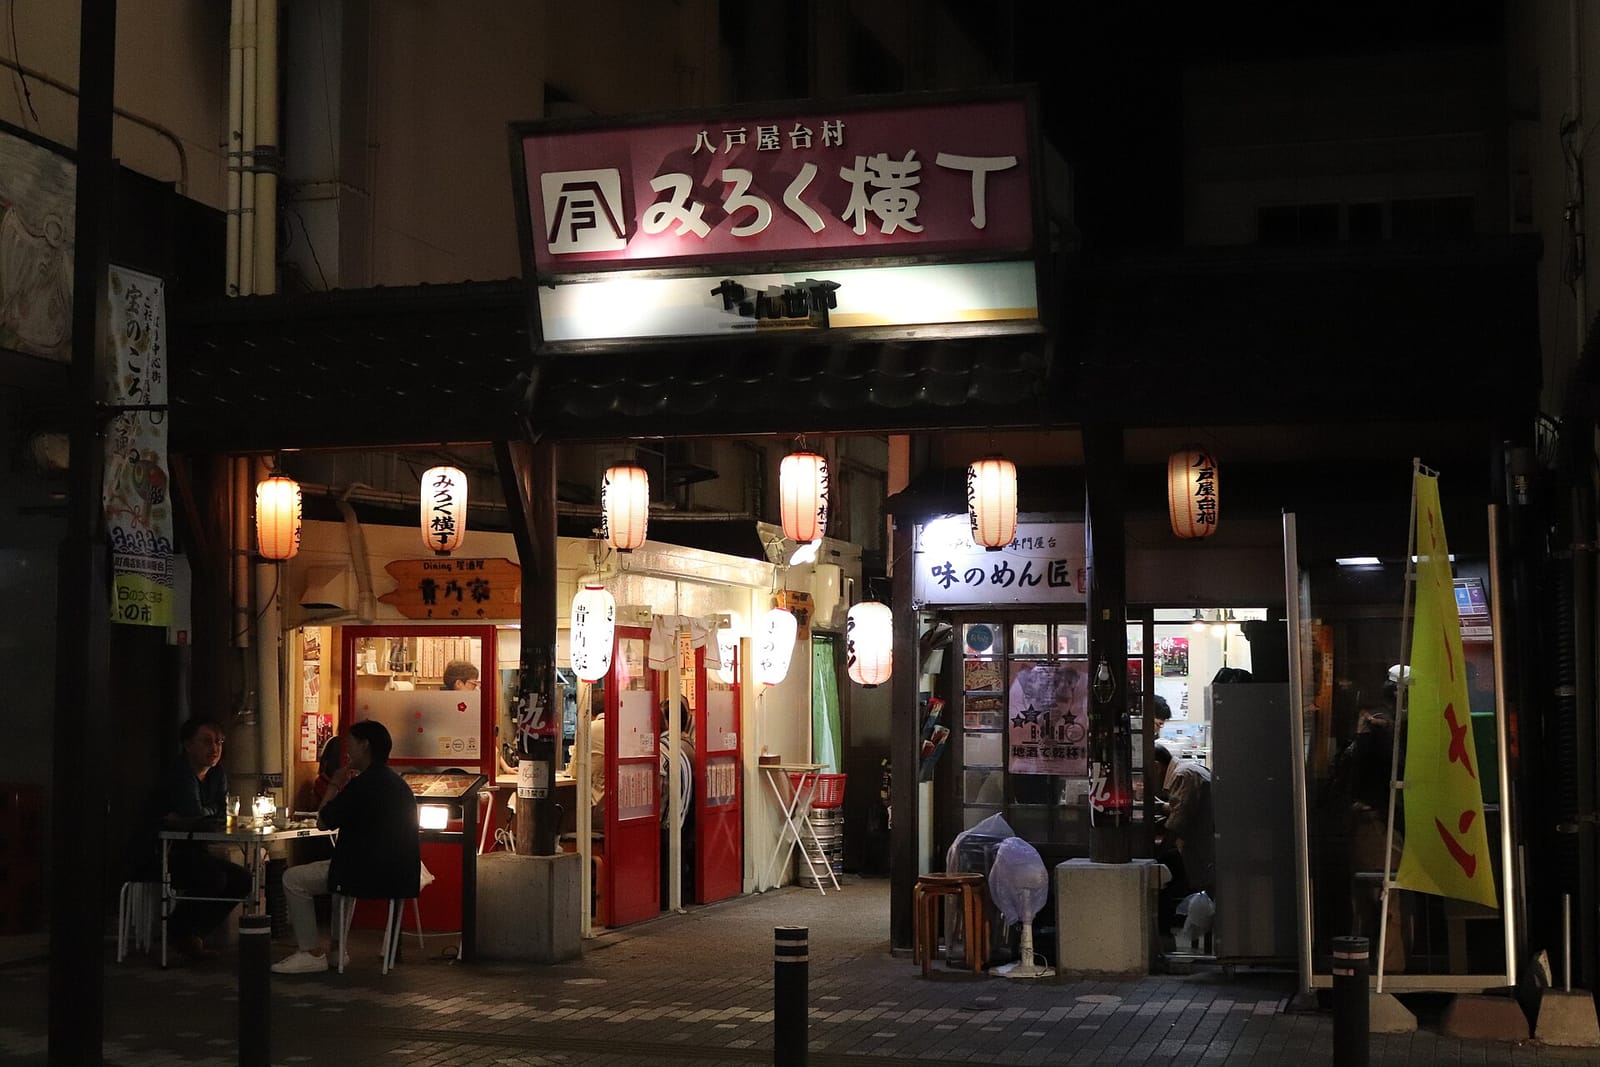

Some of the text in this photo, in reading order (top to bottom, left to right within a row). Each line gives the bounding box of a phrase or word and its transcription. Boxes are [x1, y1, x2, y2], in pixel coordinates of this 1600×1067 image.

[691, 119, 847, 155] 八戸屋台村
[641, 148, 1018, 238] みろく横丁
[430, 474, 456, 544] みろく横丁
[1192, 454, 1217, 525] 八戸屋台村
[423, 561, 452, 572] Dining
[931, 560, 1071, 590] 味のめん匠
